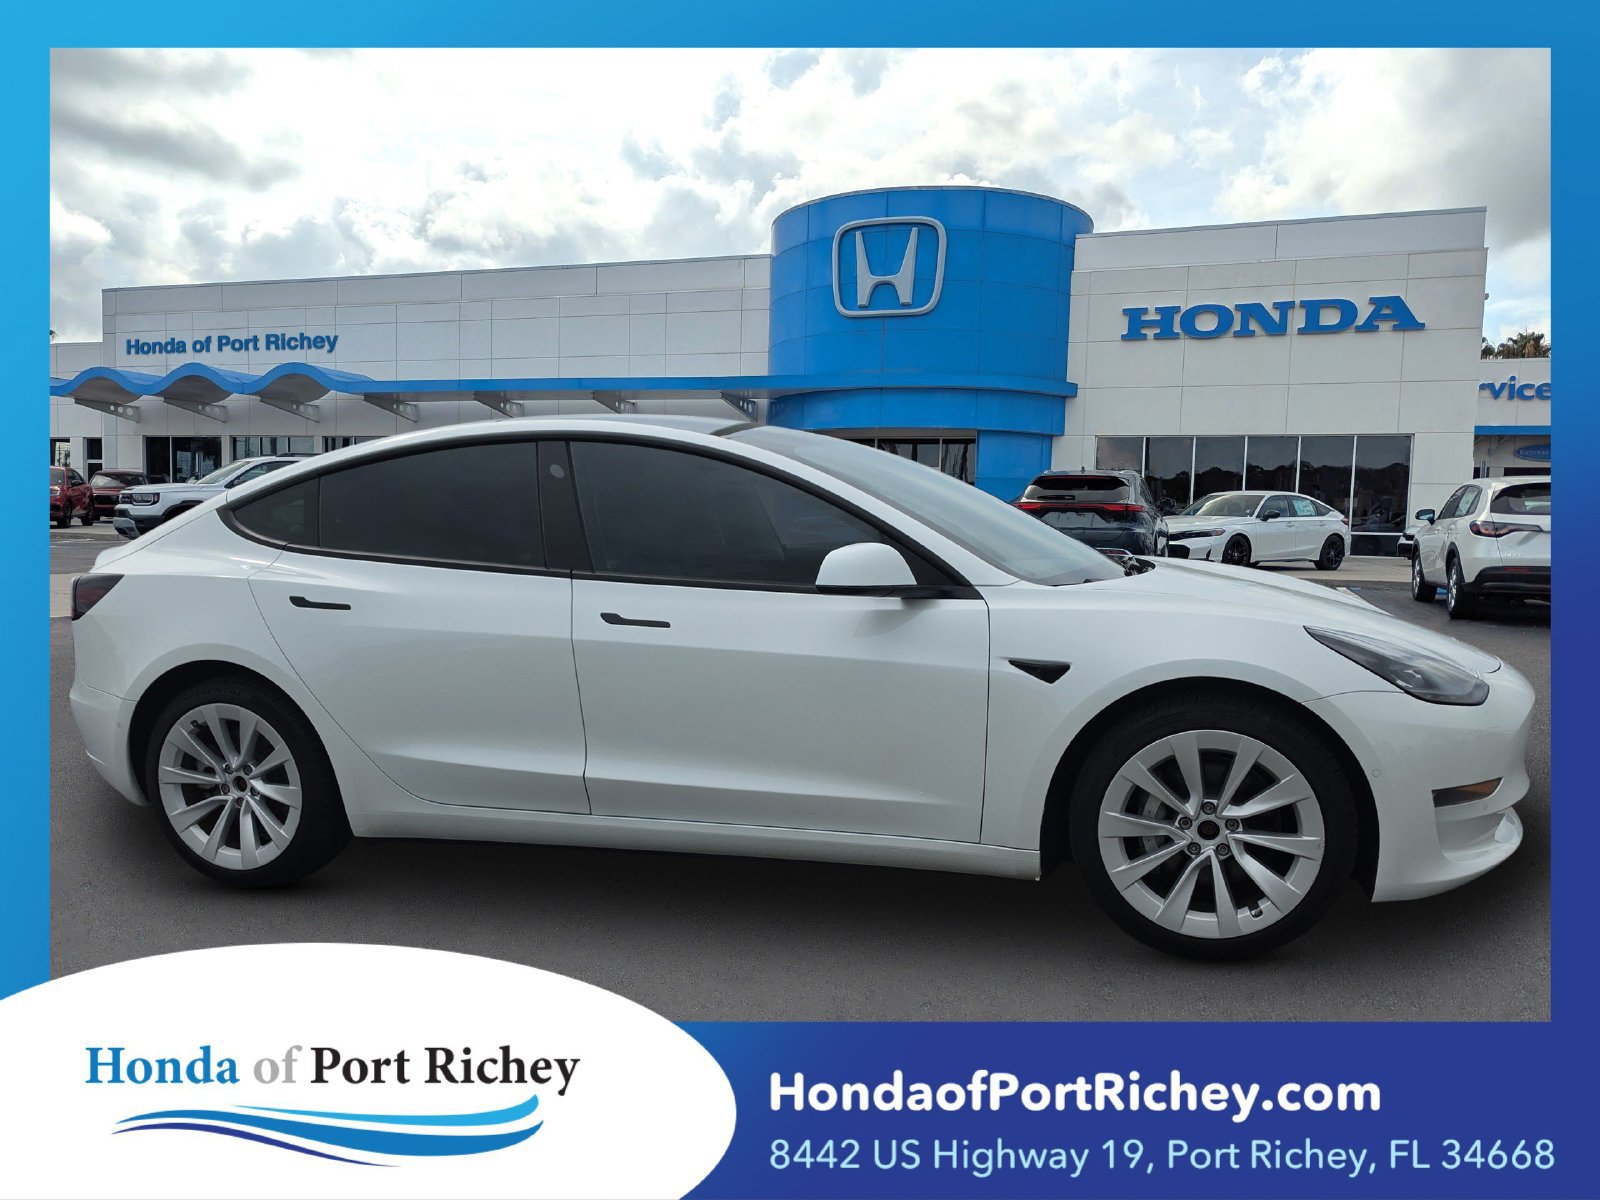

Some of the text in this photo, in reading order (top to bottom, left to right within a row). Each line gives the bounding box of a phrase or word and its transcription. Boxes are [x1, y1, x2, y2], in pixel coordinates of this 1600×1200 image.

[1120, 294, 1425, 341] HONDA
[125, 332, 338, 356] Honda of Port Richey
